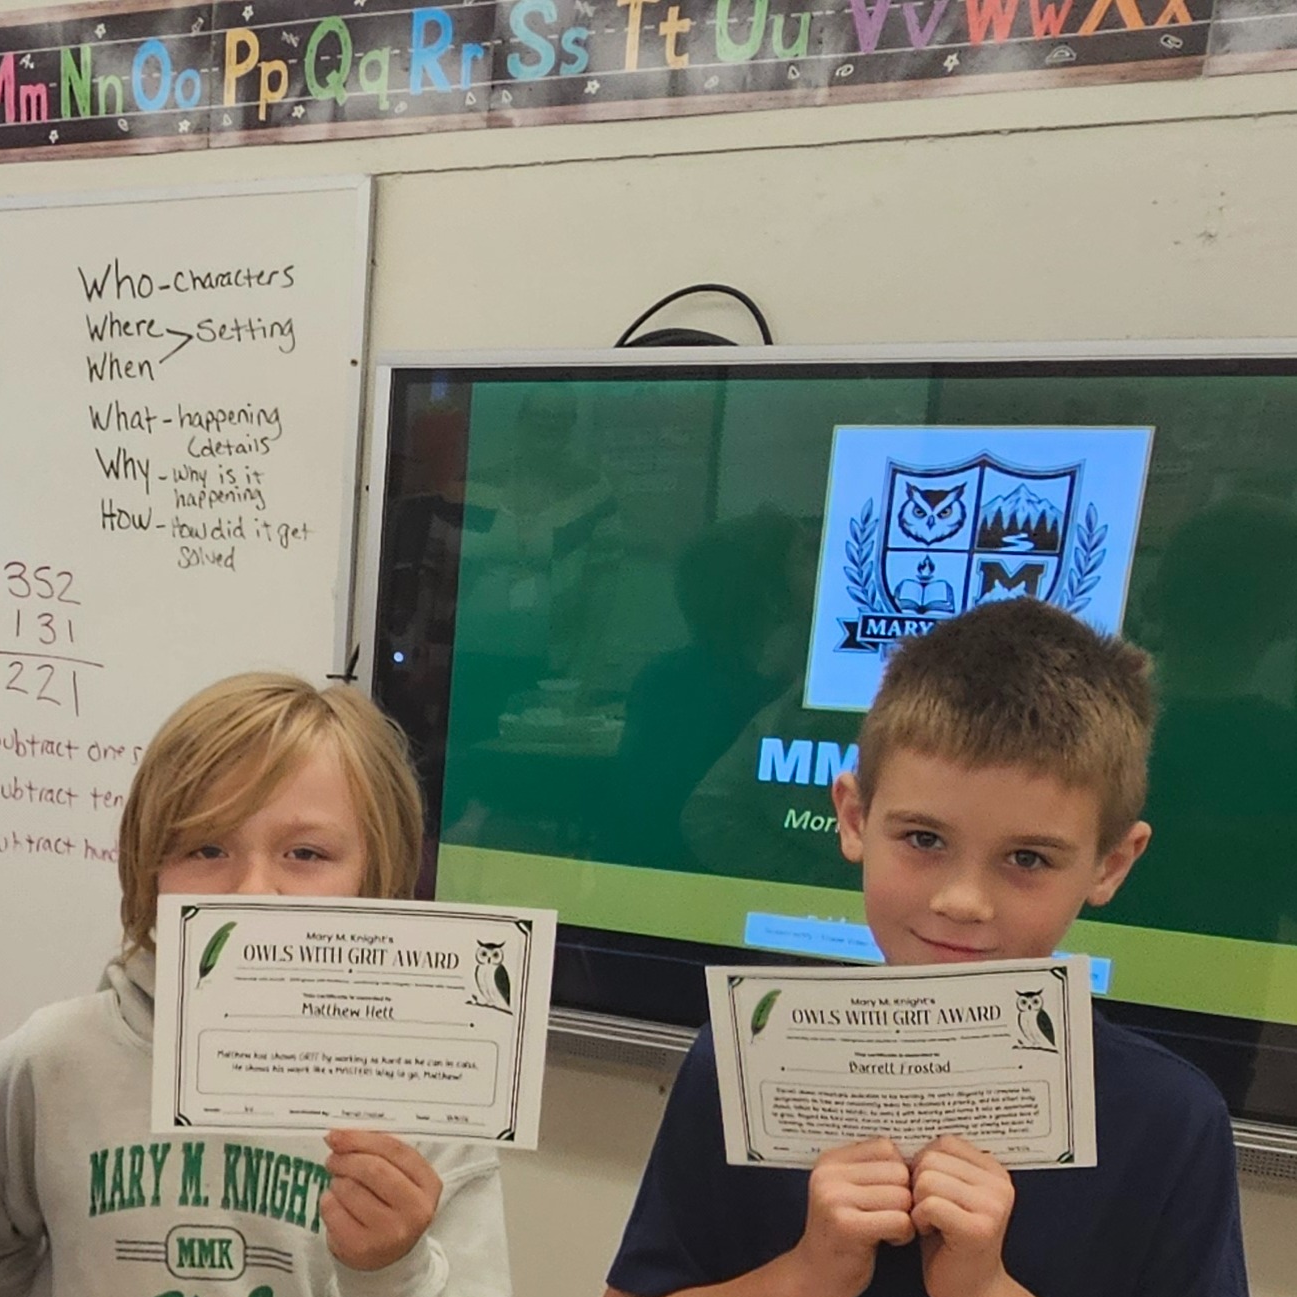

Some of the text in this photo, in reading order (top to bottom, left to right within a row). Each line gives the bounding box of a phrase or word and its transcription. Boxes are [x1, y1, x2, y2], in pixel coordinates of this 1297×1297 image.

[60, 43, 124, 119] Nn
[132, 38, 202, 113] Oo
[223, 27, 289, 121] Pp
[305, 16, 391, 110] Qq
[409, 7, 485, 95] Rr
[506, 0, 590, 81] Ss
[617, 0, 694, 71] Tt
[86, 311, 164, 343] Where
[86, 352, 155, 383] When
[218, 463, 237, 485] is
[245, 465, 265, 485] it
[174, 486, 267, 512] happening
[101, 497, 152, 532] How
[210, 516, 246, 541] did
[254, 518, 273, 542] it
[277, 521, 316, 549] get
[177, 545, 237, 572] solved
[4, 561, 82, 606] 352
[757, 737, 860, 787] MM
[90, 785, 125, 811] ten
[783, 808, 841, 833] Mor
[306, 931, 333, 944] Mary
[350, 933, 395, 946] Knight's
[243, 944, 460, 970] OWLS WITH GRIT AWARD
[302, 1002, 360, 1018] Matthew
[791, 1004, 1002, 1026] OWLS WITH GRIT AWARD
[89, 1141, 332, 1235] MARY M. KNIGHT
[176, 1236, 234, 1271] MMK
